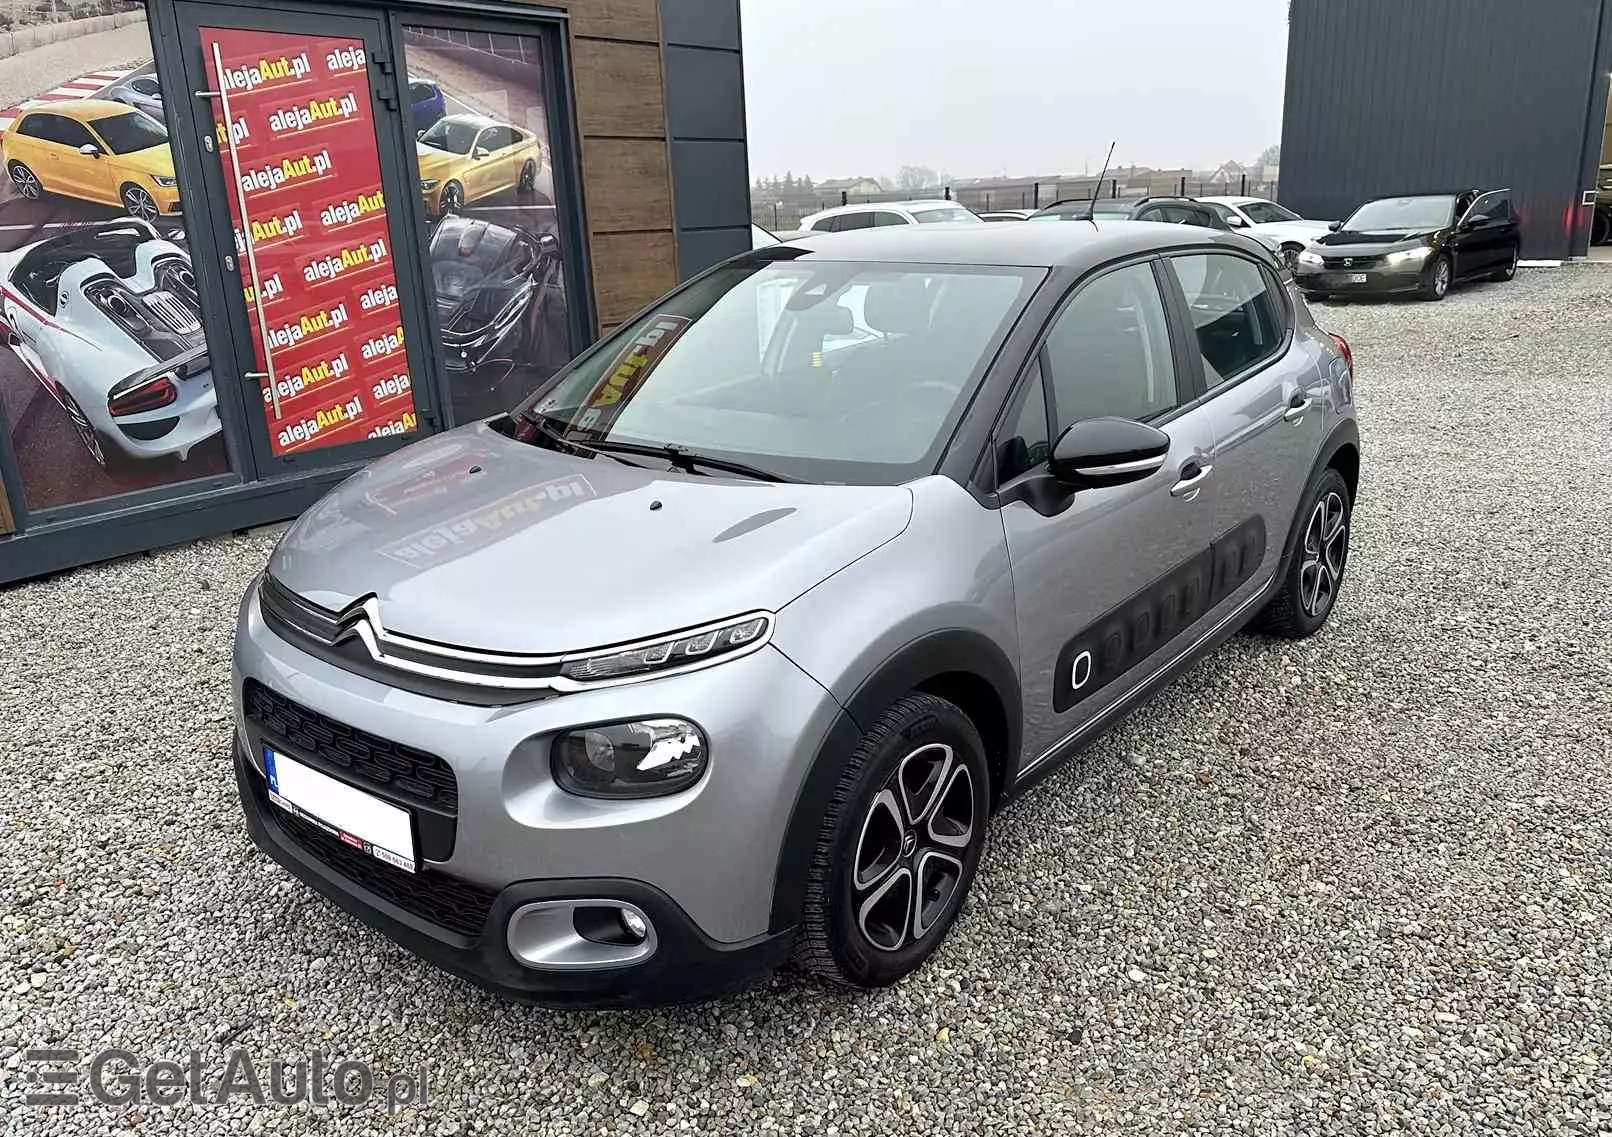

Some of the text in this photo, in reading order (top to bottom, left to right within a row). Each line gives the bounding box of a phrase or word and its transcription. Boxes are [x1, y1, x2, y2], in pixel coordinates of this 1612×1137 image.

[326, 46, 366, 71] aleja
[269, 92, 358, 132] alejaAut.pl
[241, 150, 332, 192] alejaAut.pl
[320, 190, 386, 227] alejaAut
[304, 238, 387, 282] alejaAut.pl
[360, 284, 398, 310] aleja
[262, 353, 349, 404] aejaAut.pl
[373, 373, 411, 400] aleja
[278, 396, 363, 448] alejaAut.pl
